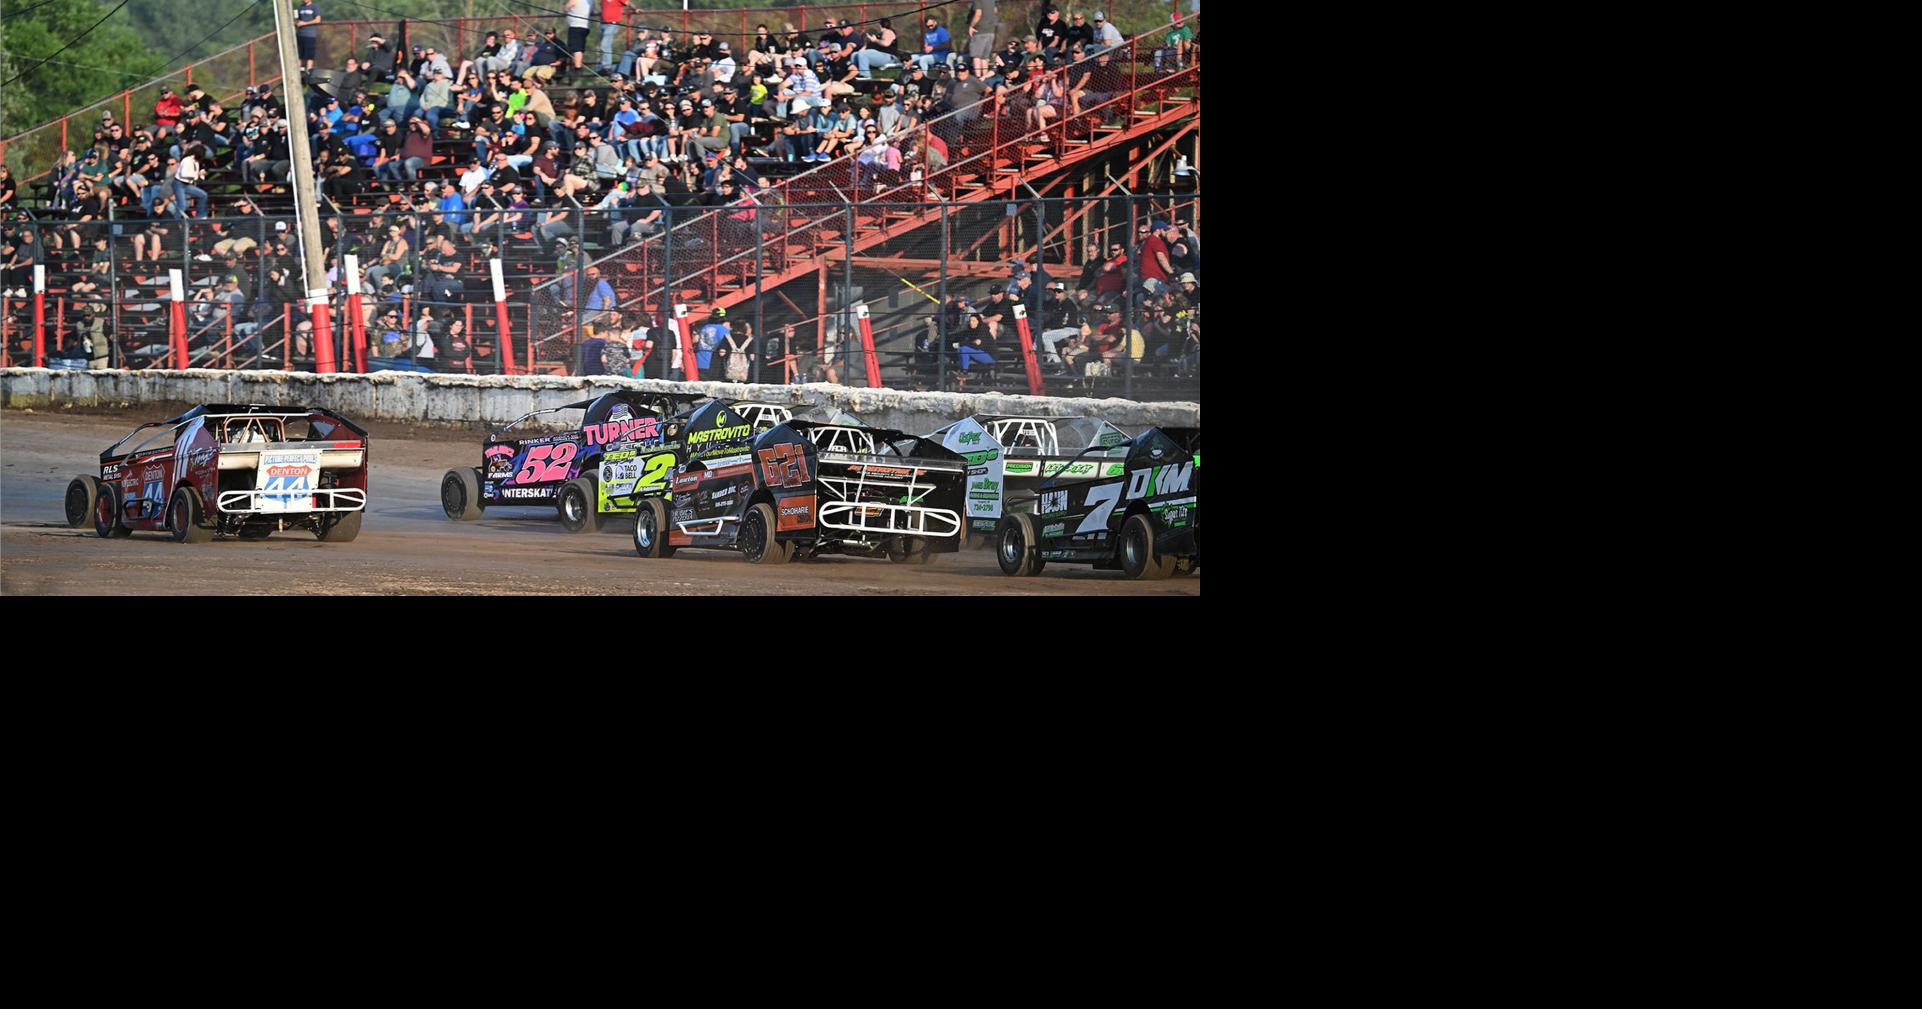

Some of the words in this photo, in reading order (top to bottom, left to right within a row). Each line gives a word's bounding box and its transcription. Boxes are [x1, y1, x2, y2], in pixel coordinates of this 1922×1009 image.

[583, 417, 659, 446] TURNER
[687, 424, 751, 444] MASTROVITO
[103, 464, 119, 475] RLS
[270, 467, 309, 476] DENTON
[516, 443, 578, 485] 52
[634, 453, 676, 494] 2
[758, 443, 811, 488] 621
[1125, 461, 1194, 500] DKM
[781, 505, 809, 515] SCHOHARIE
[1075, 482, 1125, 535] 7
